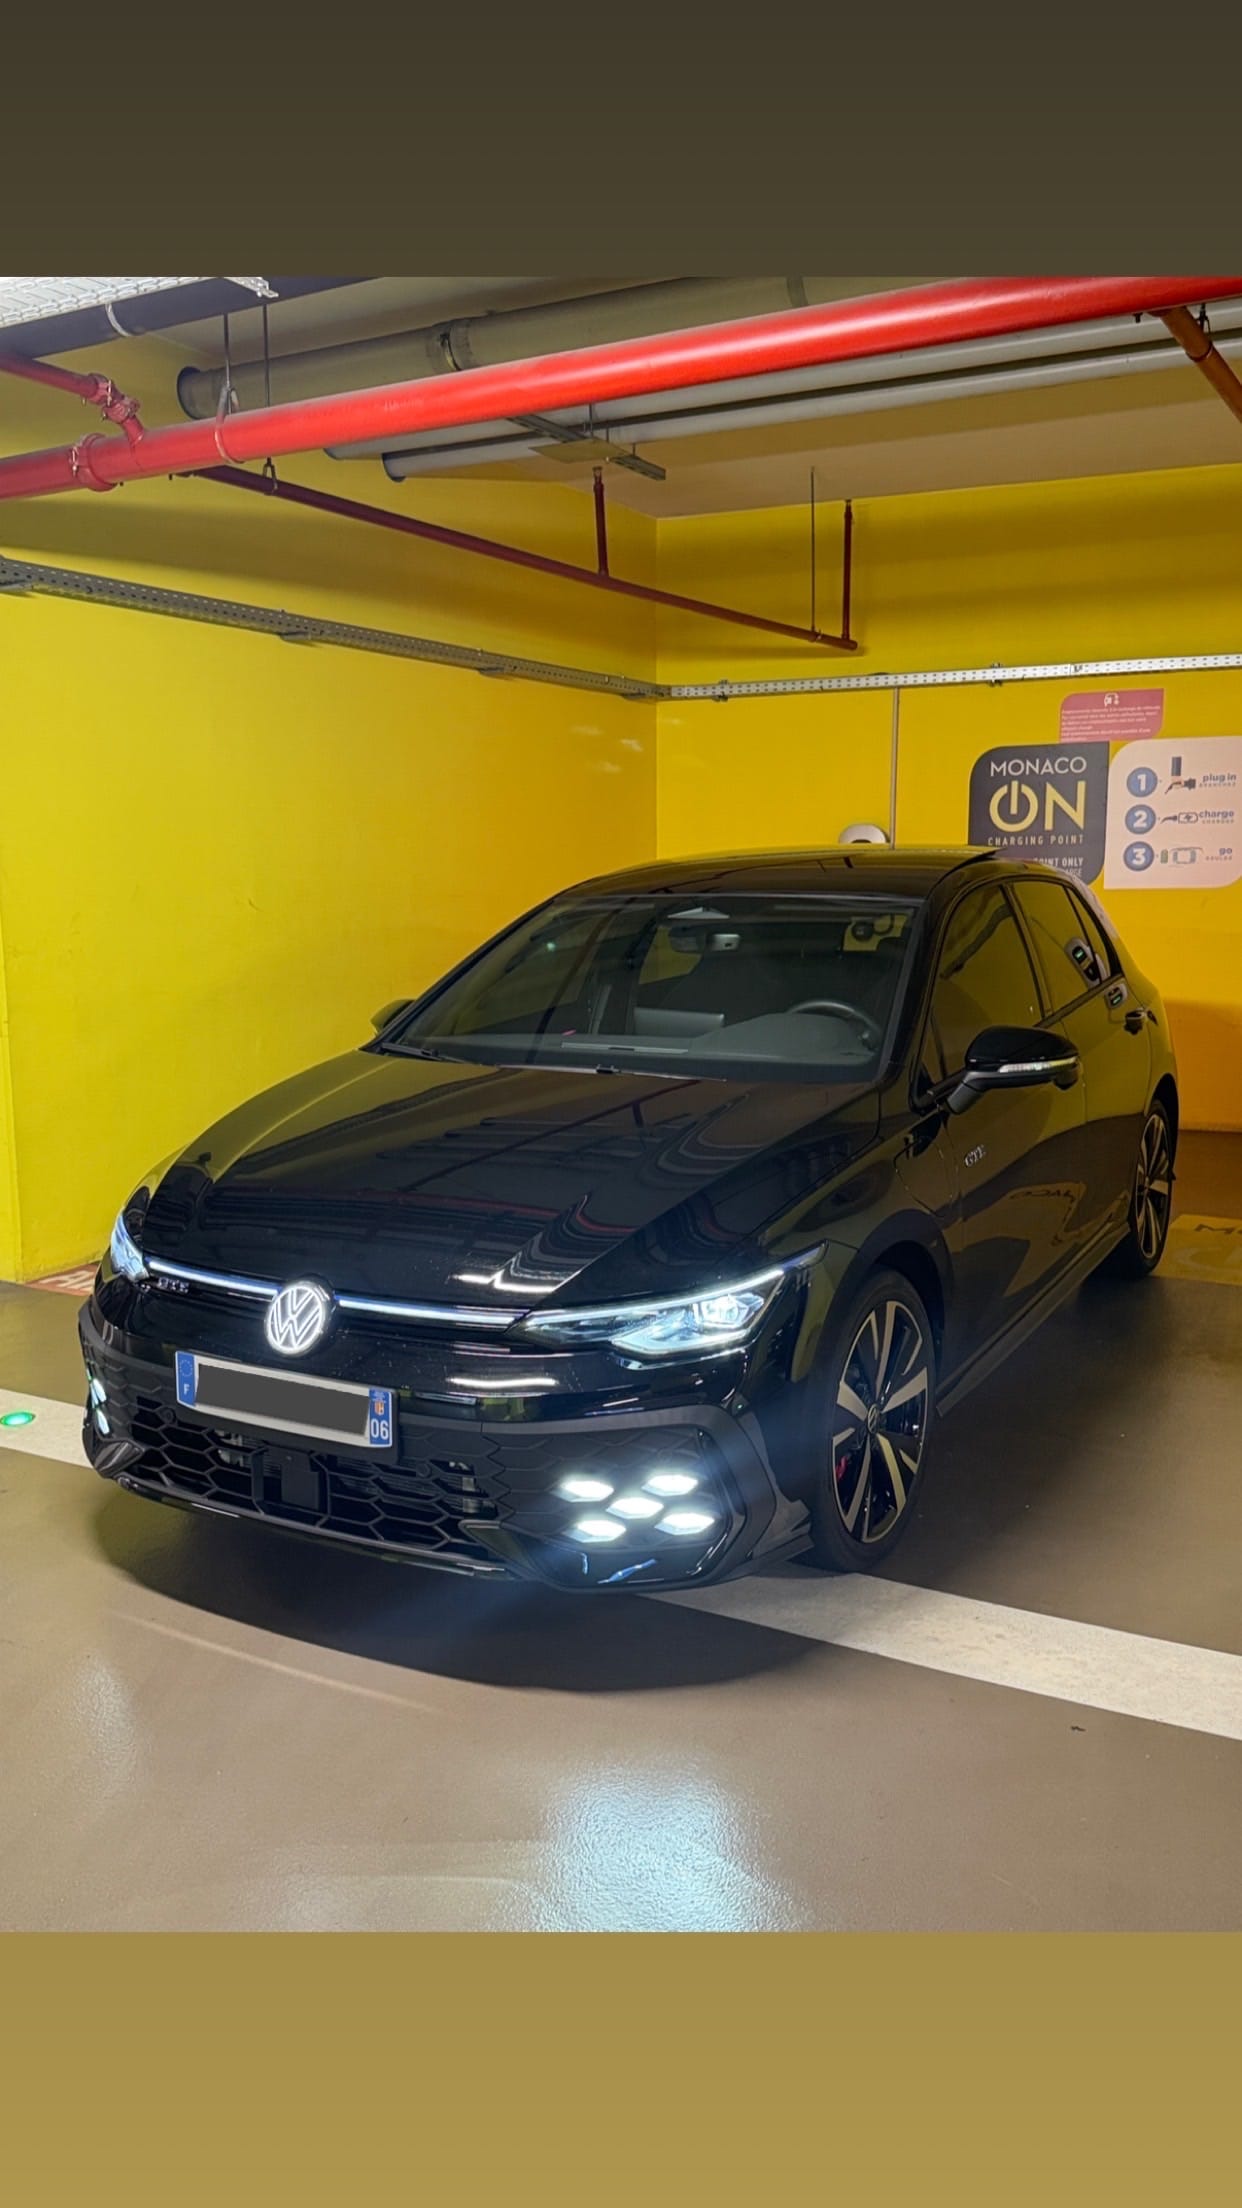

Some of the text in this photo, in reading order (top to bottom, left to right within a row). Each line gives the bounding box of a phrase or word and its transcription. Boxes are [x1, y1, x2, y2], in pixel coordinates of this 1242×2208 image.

[990, 756, 1087, 777] MONACO
[1137, 774, 1147, 791] 1
[1202, 773, 1226, 783] plug
[989, 780, 1086, 833] ON
[1132, 809, 1148, 828] 2
[1199, 810, 1235, 819] charge
[987, 834, 1084, 847] CHARGING POINT
[1131, 847, 1147, 866] 3
[1219, 847, 1233, 856] go
[1062, 857, 1084, 868] ONLY
[183, 1384, 190, 1395] F
[371, 1418, 389, 1440] 06
